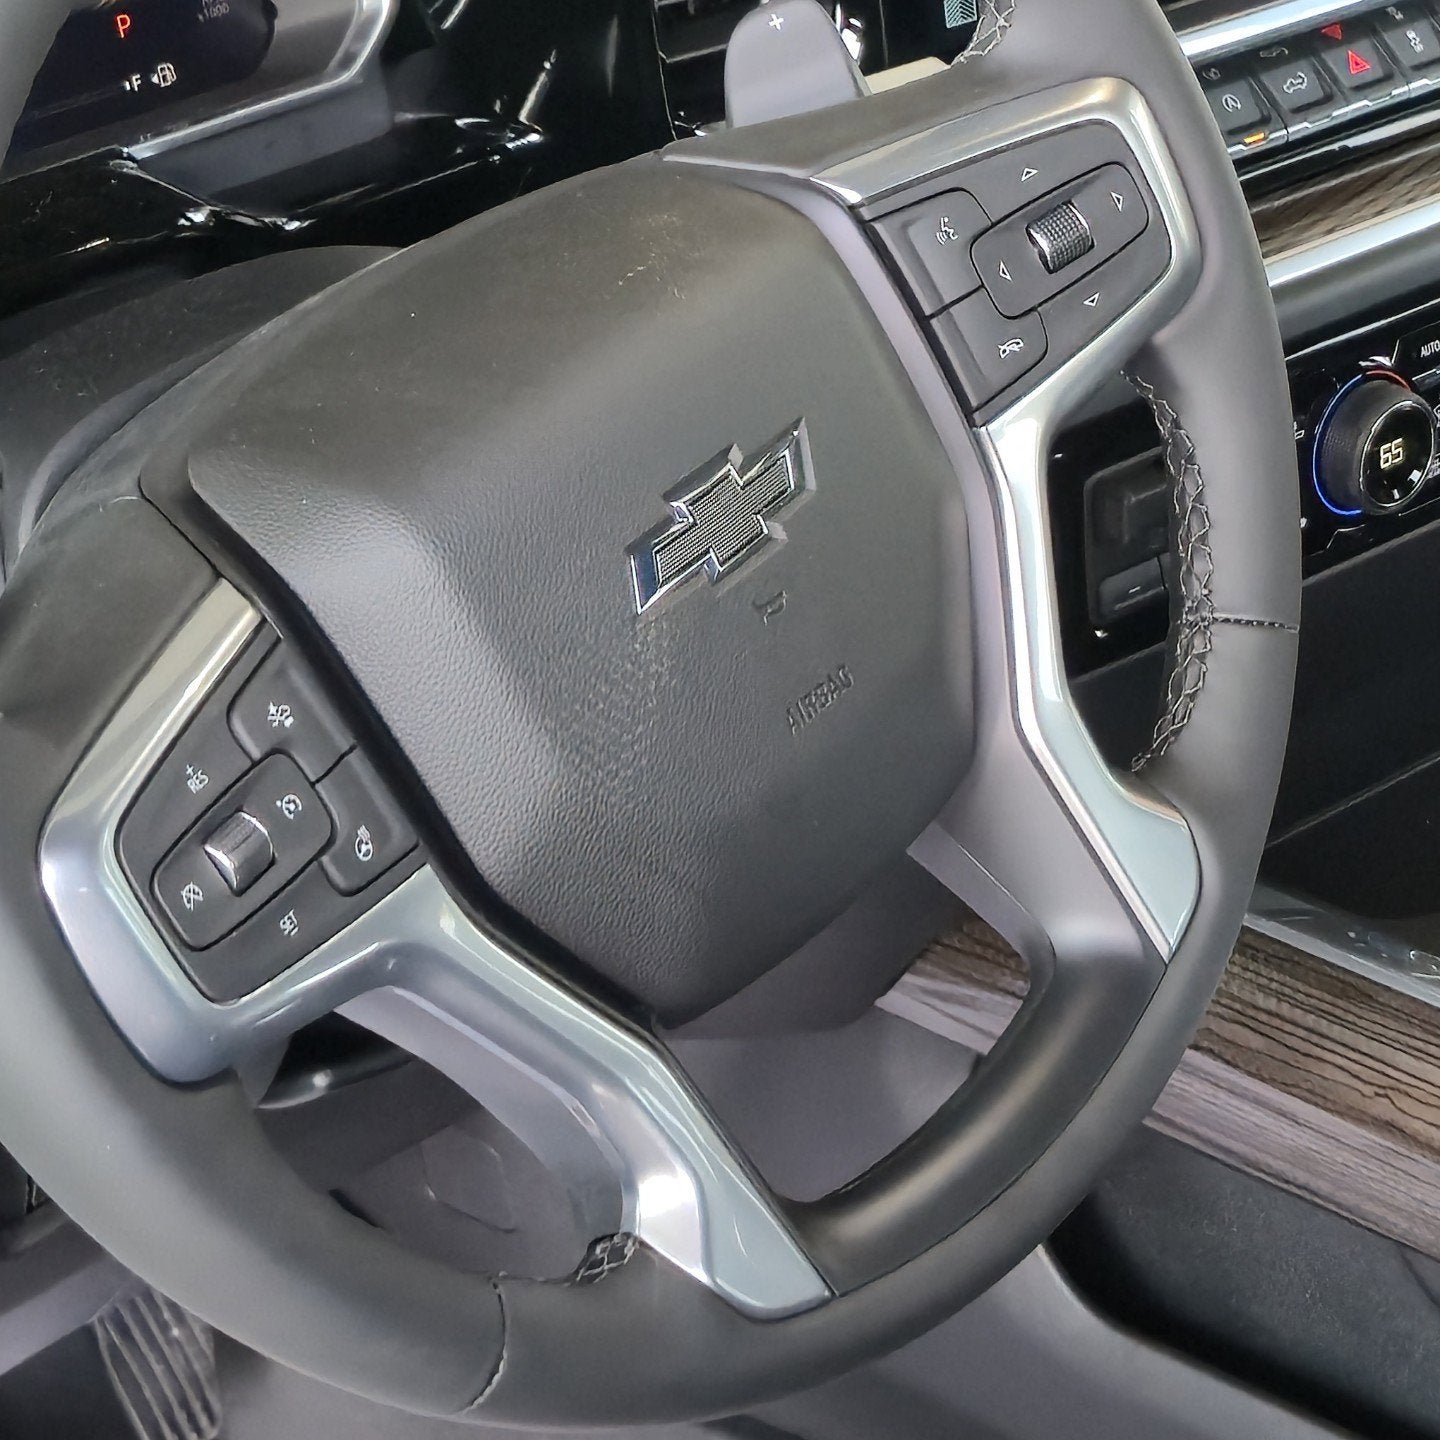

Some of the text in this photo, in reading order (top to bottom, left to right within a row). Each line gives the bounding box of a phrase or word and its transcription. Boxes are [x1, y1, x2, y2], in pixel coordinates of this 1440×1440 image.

[116, 13, 132, 39] P
[132, 72, 142, 93] F
[1419, 339, 1440, 358] AUTO
[1379, 437, 1404, 470] 65
[785, 663, 856, 736] AIRBAG
[186, 769, 210, 795] RES
